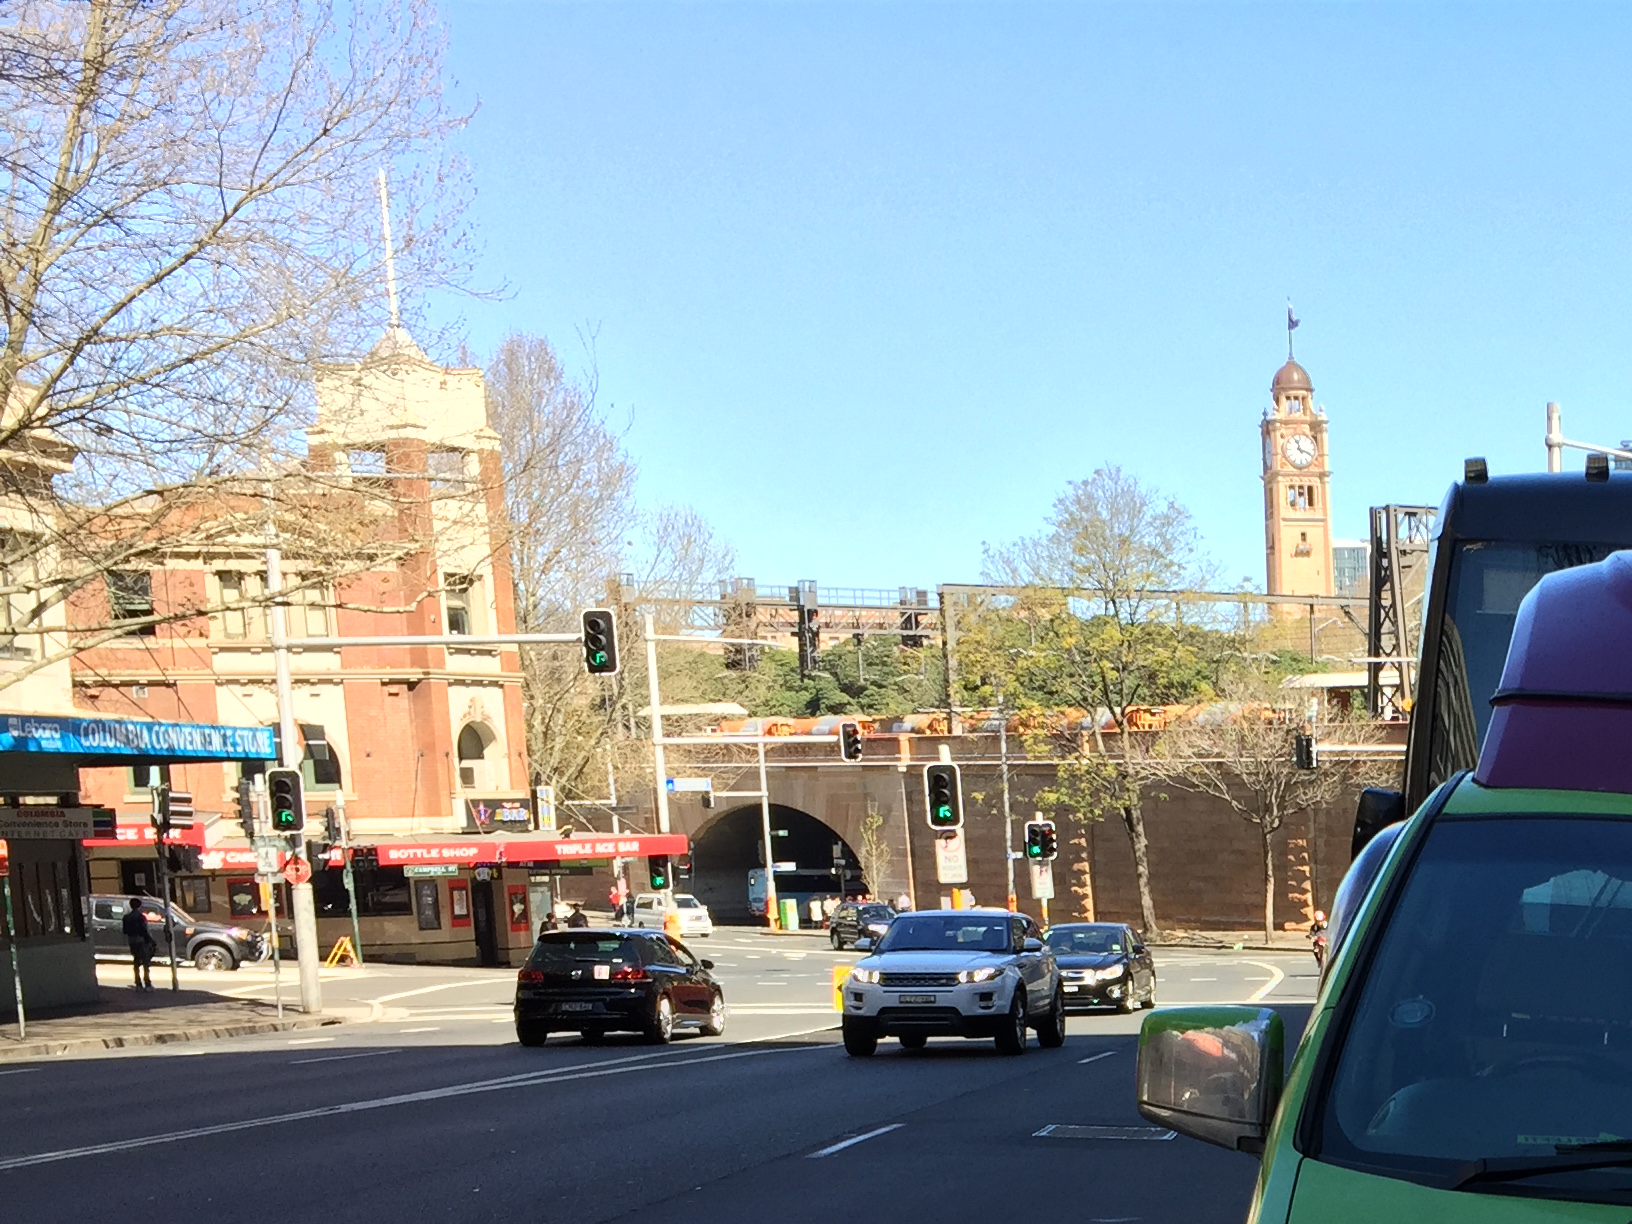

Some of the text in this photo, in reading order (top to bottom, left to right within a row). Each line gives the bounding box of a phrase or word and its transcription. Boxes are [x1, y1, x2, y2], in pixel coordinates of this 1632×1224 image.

[18, 717, 60, 738] Lebara
[80, 722, 272, 754] COLUMBIA CONVENIENCE STORE
[388, 847, 478, 859] BOTTLE SHOP
[554, 841, 640, 855] TRIPLE ACE BAR
[944, 855, 959, 863] NO
